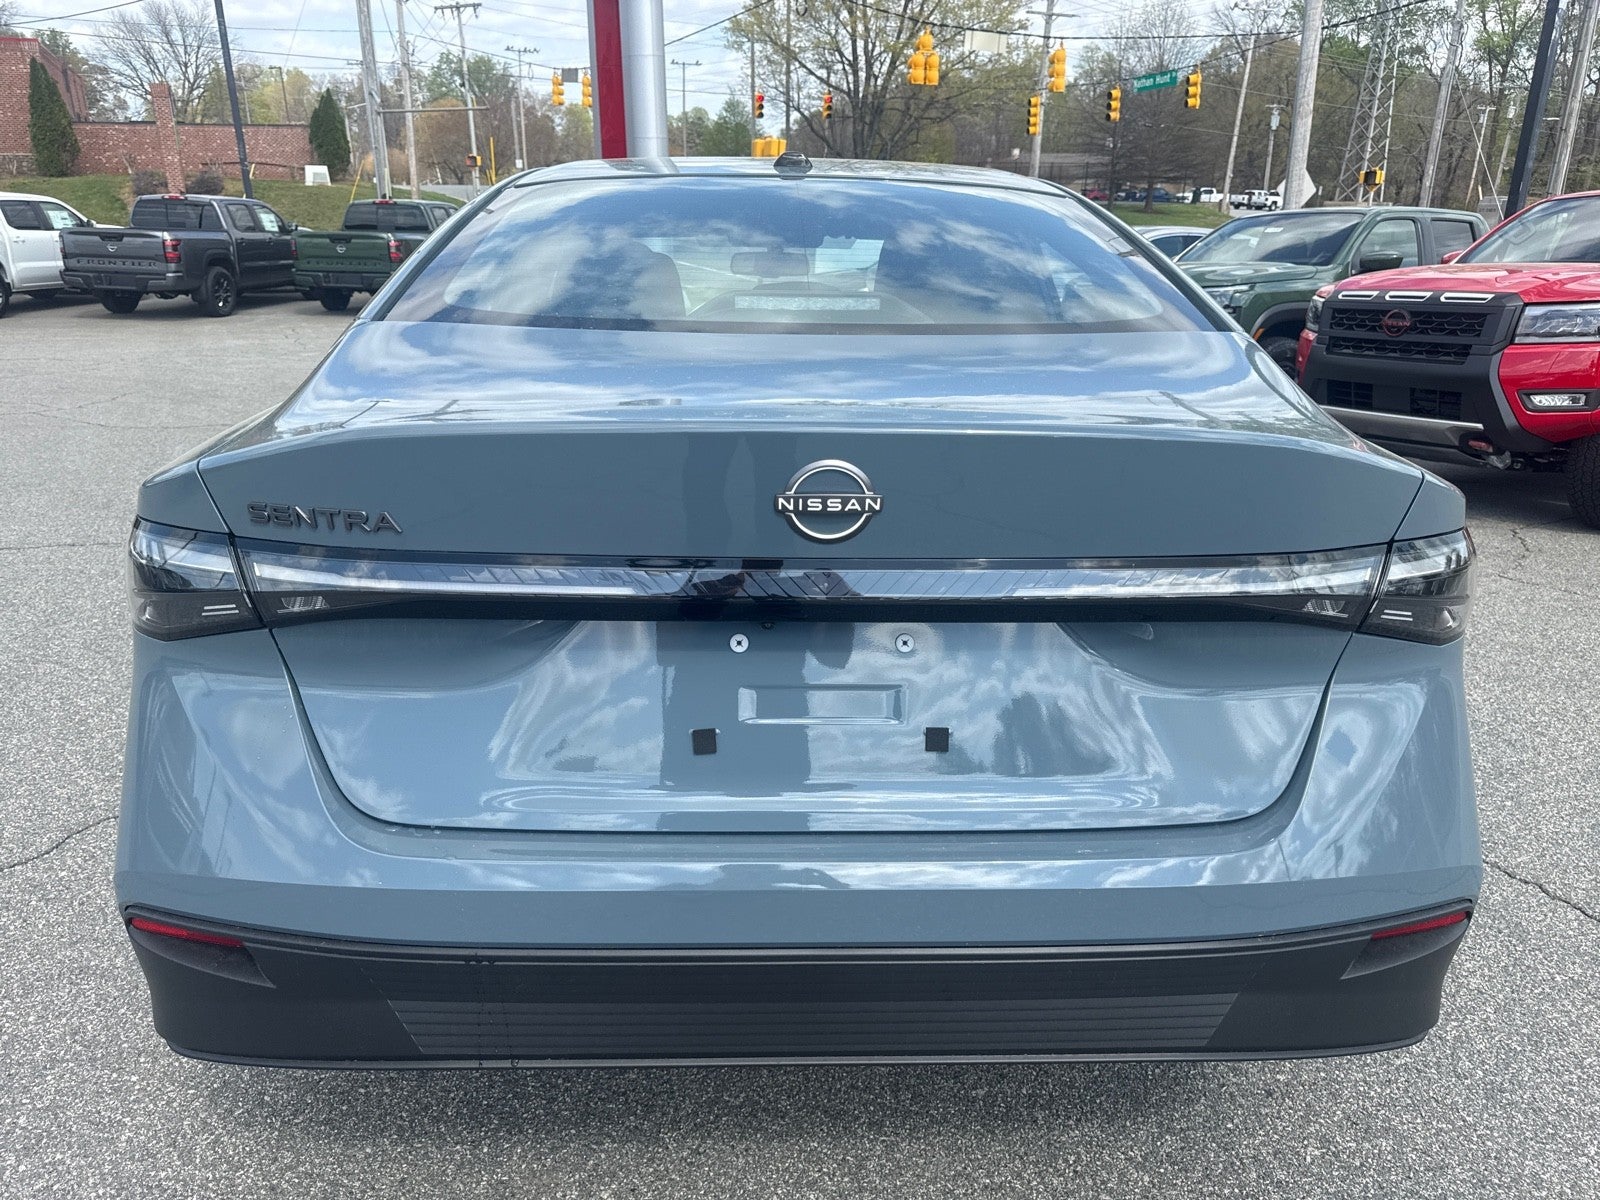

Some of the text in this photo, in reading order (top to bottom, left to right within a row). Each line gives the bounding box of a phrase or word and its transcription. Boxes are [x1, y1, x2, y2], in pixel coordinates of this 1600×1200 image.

[1155, 72, 1171, 84] Hunt
[76, 259, 157, 267] FRONTIER
[778, 498, 881, 511] NISSAN
[248, 501, 402, 533] SENTRA
